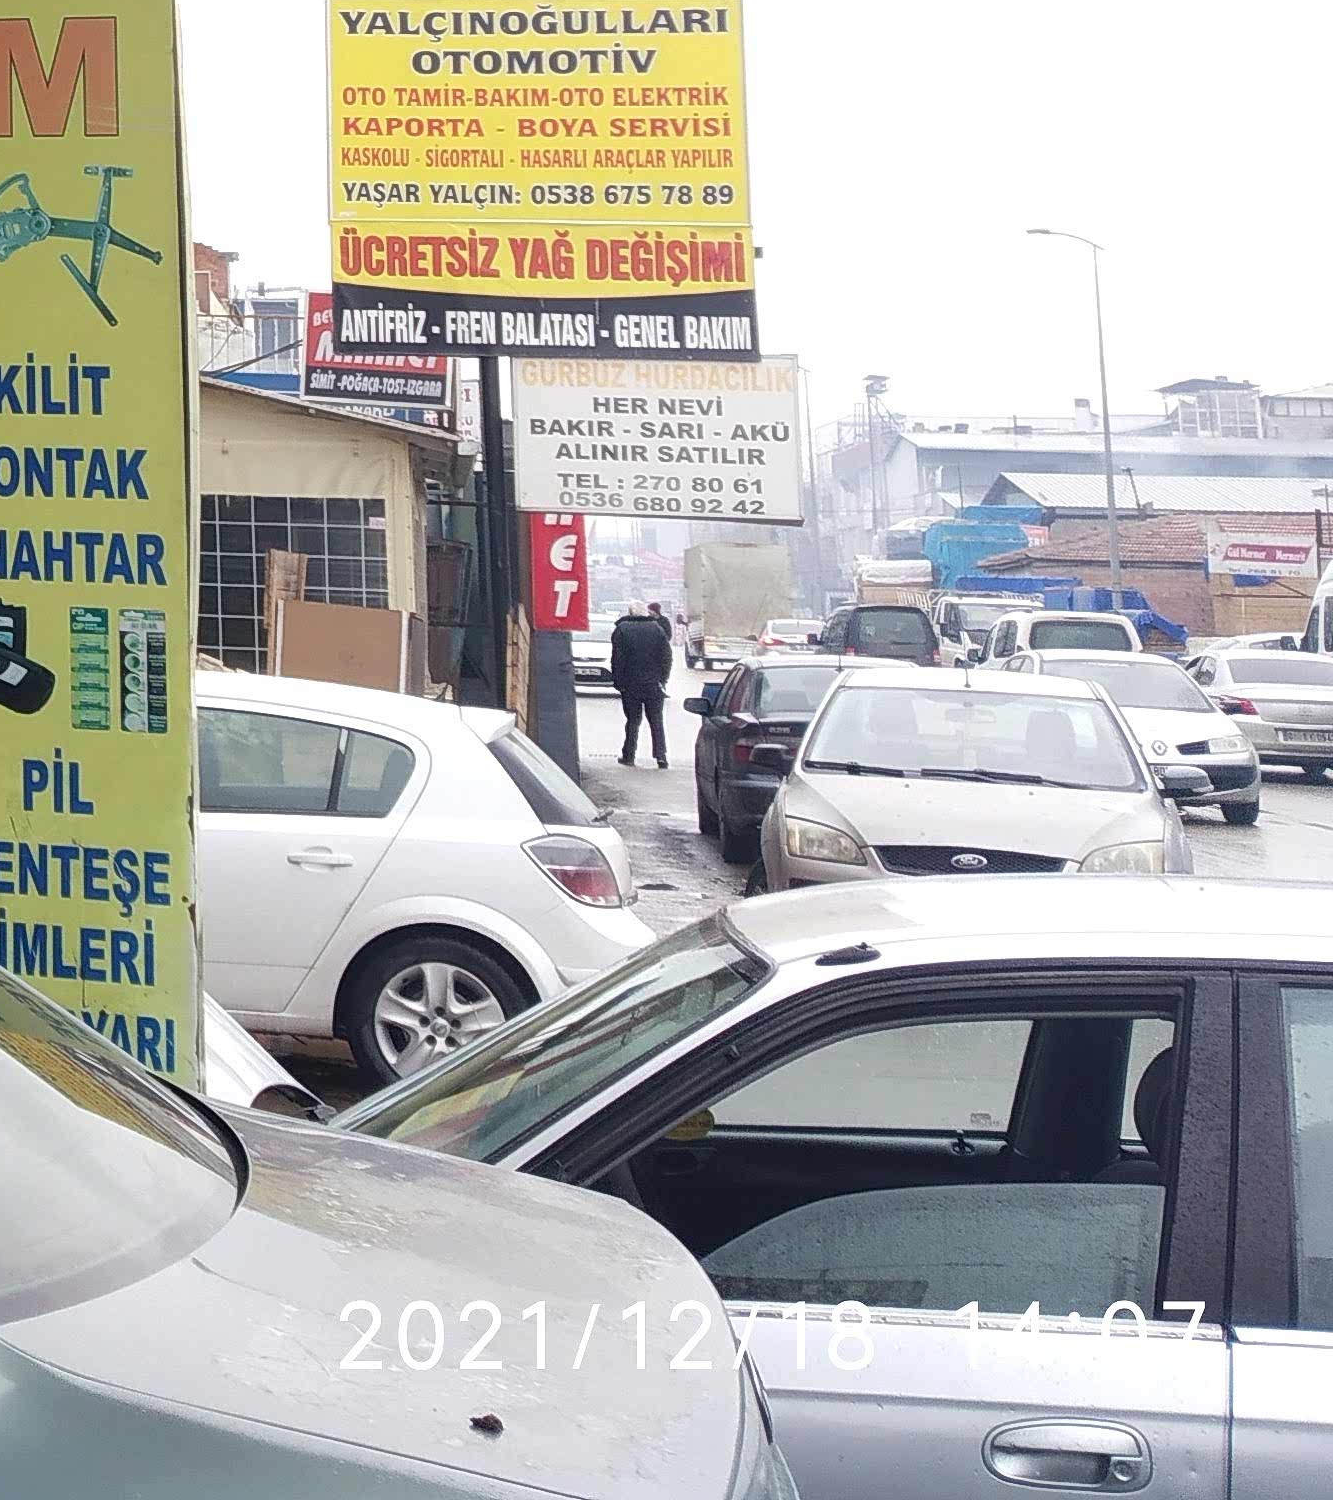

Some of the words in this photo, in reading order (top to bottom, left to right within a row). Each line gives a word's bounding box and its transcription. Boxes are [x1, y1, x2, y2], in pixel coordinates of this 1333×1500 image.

[340, 5, 729, 42] YALÇINOĞULLARI
[412, 43, 656, 74] OTOMOTİV
[343, 86, 386, 106] OTO
[613, 82, 728, 106] ELEKTRİK
[343, 117, 484, 137] KAPORTA
[518, 118, 597, 137] BOYA
[610, 112, 731, 137] SERVİSİ
[341, 148, 409, 167] KASKOLU
[426, 144, 504, 168] SİGORTALI
[521, 149, 587, 168] HASARLI
[593, 149, 665, 174] ARAÇLAR
[671, 149, 733, 168] YAPILIR
[343, 183, 419, 208] YAŞAR
[431, 184, 521, 209] YALÇIN:
[533, 185, 595, 205] 0538
[604, 185, 651, 205] 675
[662, 185, 693, 205] 78
[703, 185, 734, 205] 89
[339, 228, 501, 278] ÜCRETSİZ
[509, 230, 574, 280] YAĞ
[587, 231, 746, 287] DEĞİŞİMİ
[341, 302, 427, 344] ANTİFRİZ
[445, 311, 496, 345] FREN
[502, 312, 595, 347] BALATASI
[614, 314, 680, 349] GENEL
[686, 316, 752, 350] BAKIM
[593, 397, 648, 415] HER
[658, 396, 723, 416] NEVİ
[529, 418, 615, 438] BAKIR
[640, 421, 703, 440] SARI
[730, 422, 790, 442] AKÜ
[555, 443, 649, 463] ALINIR
[657, 445, 766, 465] SATILIR
[557, 473, 609, 490] TEL
[633, 474, 681, 492] 270
[691, 477, 723, 493] 80
[733, 479, 763, 494] 61
[559, 491, 623, 508] 0536
[633, 496, 681, 512] 680
[690, 499, 723, 514] 92
[732, 500, 765, 515] 42
[23, 747, 94, 816] PİL
[69, 1009, 175, 1072] YARI
